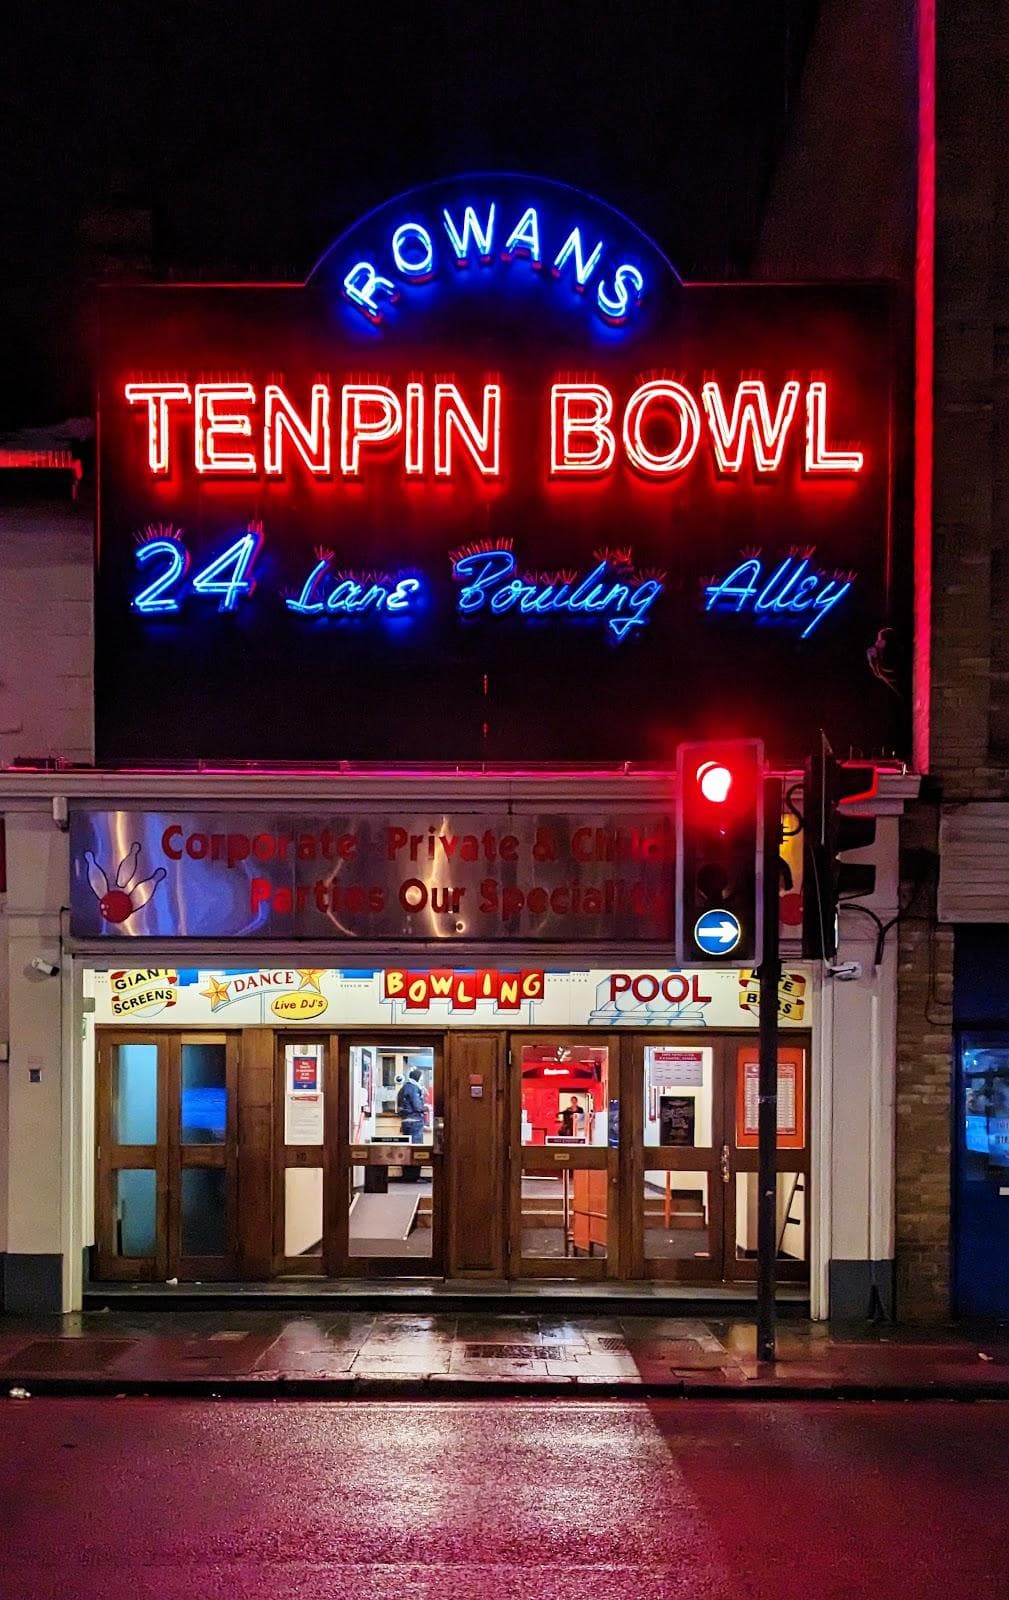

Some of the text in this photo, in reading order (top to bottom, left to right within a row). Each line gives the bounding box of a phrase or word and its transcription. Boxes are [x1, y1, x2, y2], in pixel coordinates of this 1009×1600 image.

[342, 202, 645, 318] ROWANS
[124, 379, 864, 476] TENPIN BOWL
[130, 532, 852, 640] 24 Lane Bowling Alley
[161, 825, 358, 868] Corporate
[386, 825, 520, 863] Private
[532, 825, 559, 862] &
[251, 876, 385, 914] Parties
[401, 877, 467, 914] Our
[233, 971, 294, 993] DANCE
[386, 971, 541, 1003] BOWLING
[609, 974, 712, 1003] POOL
[751, 969, 794, 992] LE
[113, 990, 173, 1014] SCREENS
[274, 998, 324, 1010] Live DJ's
[746, 993, 792, 1014] BS
